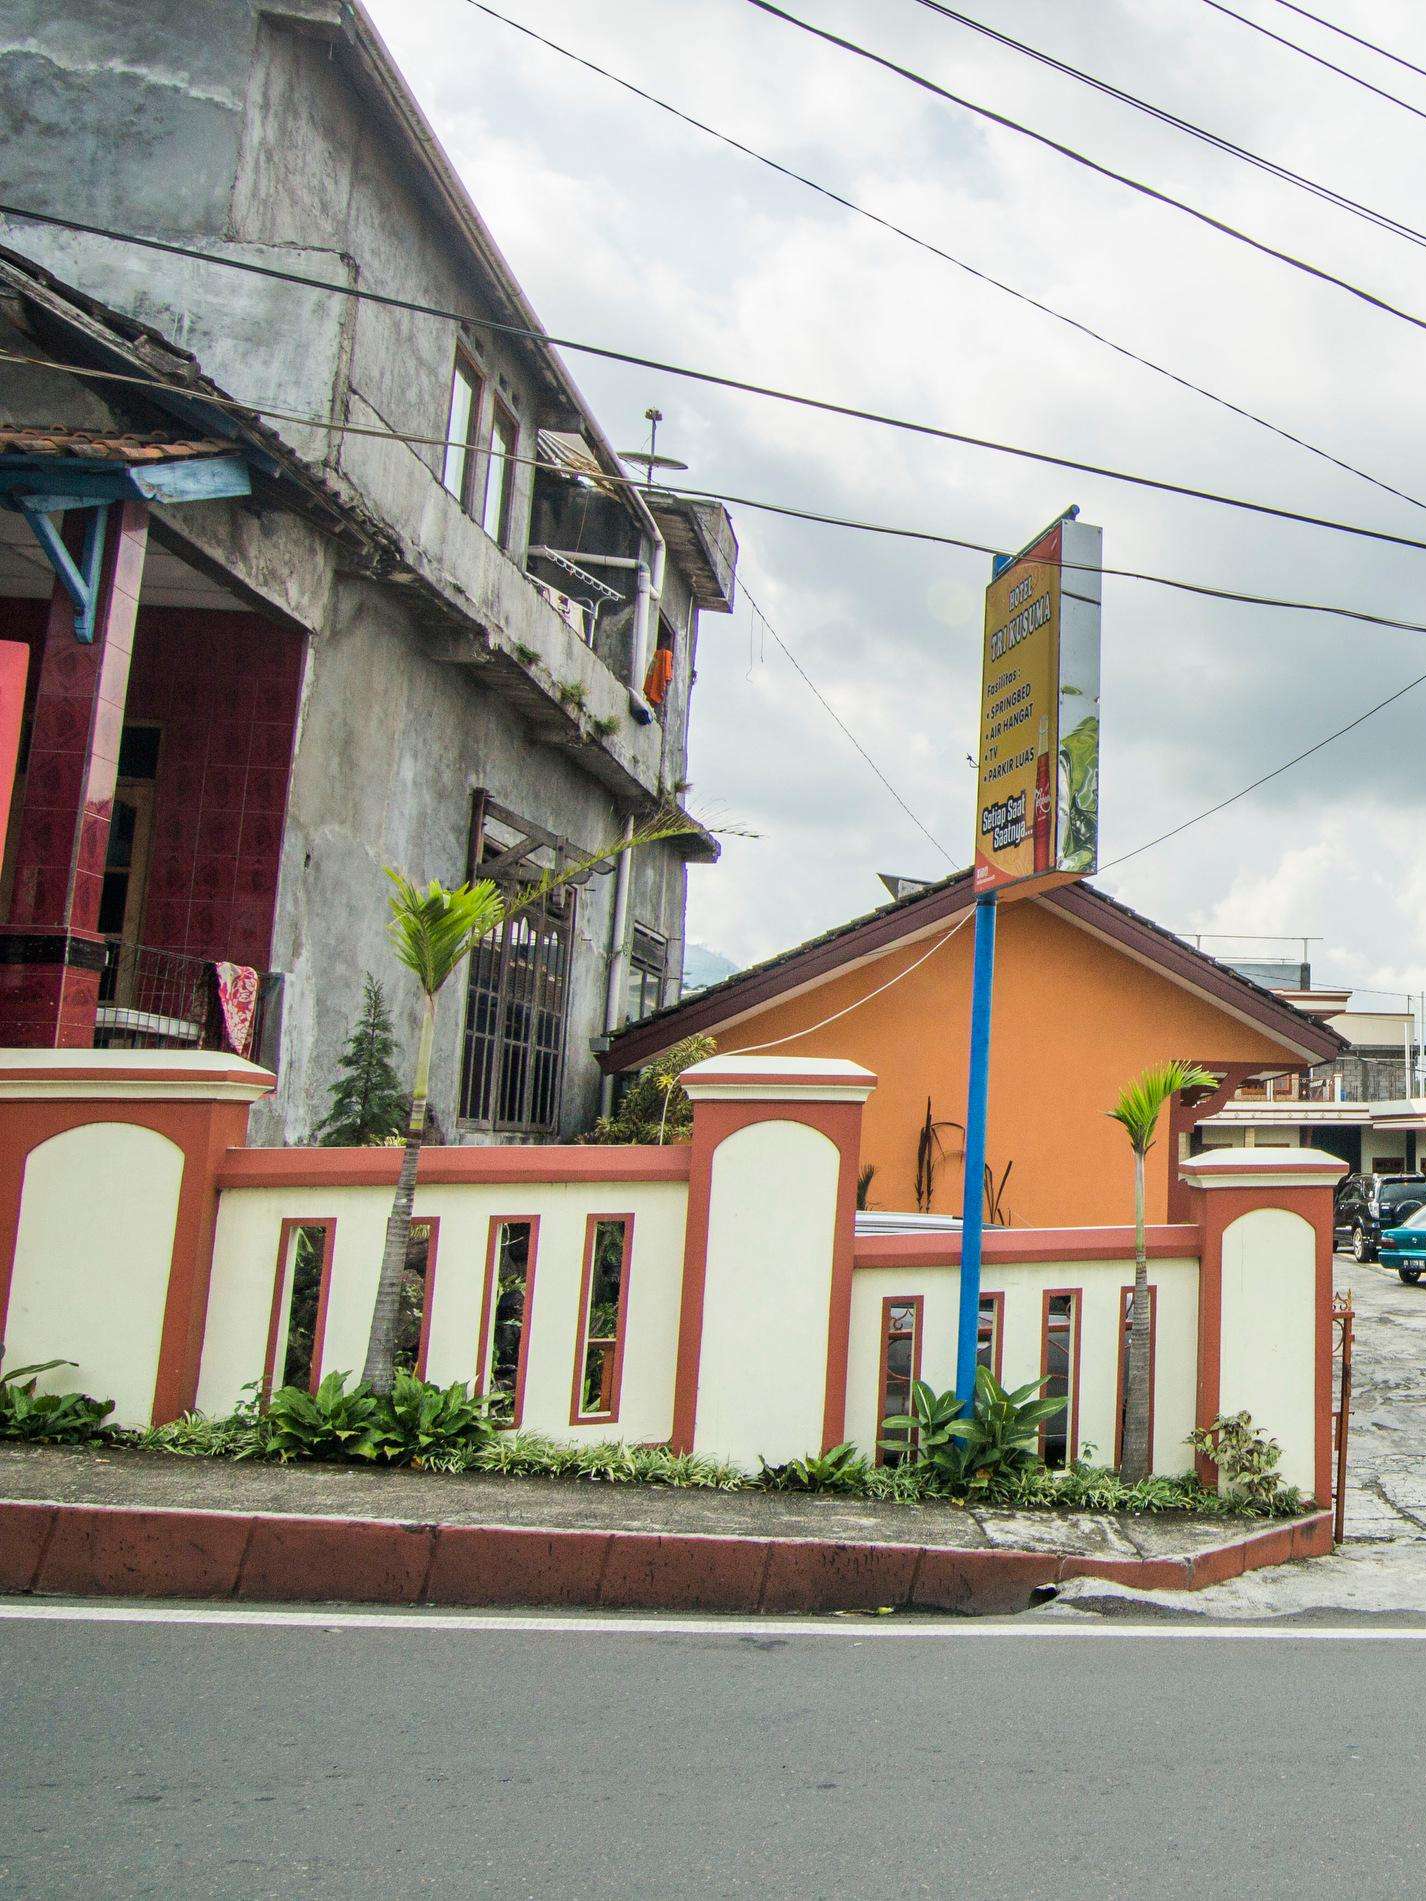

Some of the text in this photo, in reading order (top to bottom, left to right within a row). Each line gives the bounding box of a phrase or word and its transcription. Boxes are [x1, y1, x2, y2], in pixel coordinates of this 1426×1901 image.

[1008, 575, 1032, 612] HOTEL
[992, 591, 1051, 662] TRI KUSUMA
[990, 683, 1031, 719] SPRINGBED
[990, 702, 1034, 740] AIR HANGAT
[988, 746, 1034, 783] PARKIR LUAS
[989, 746, 998, 761] TV
[983, 805, 1006, 832] Setiap
[1007, 794, 1026, 821] Saat
